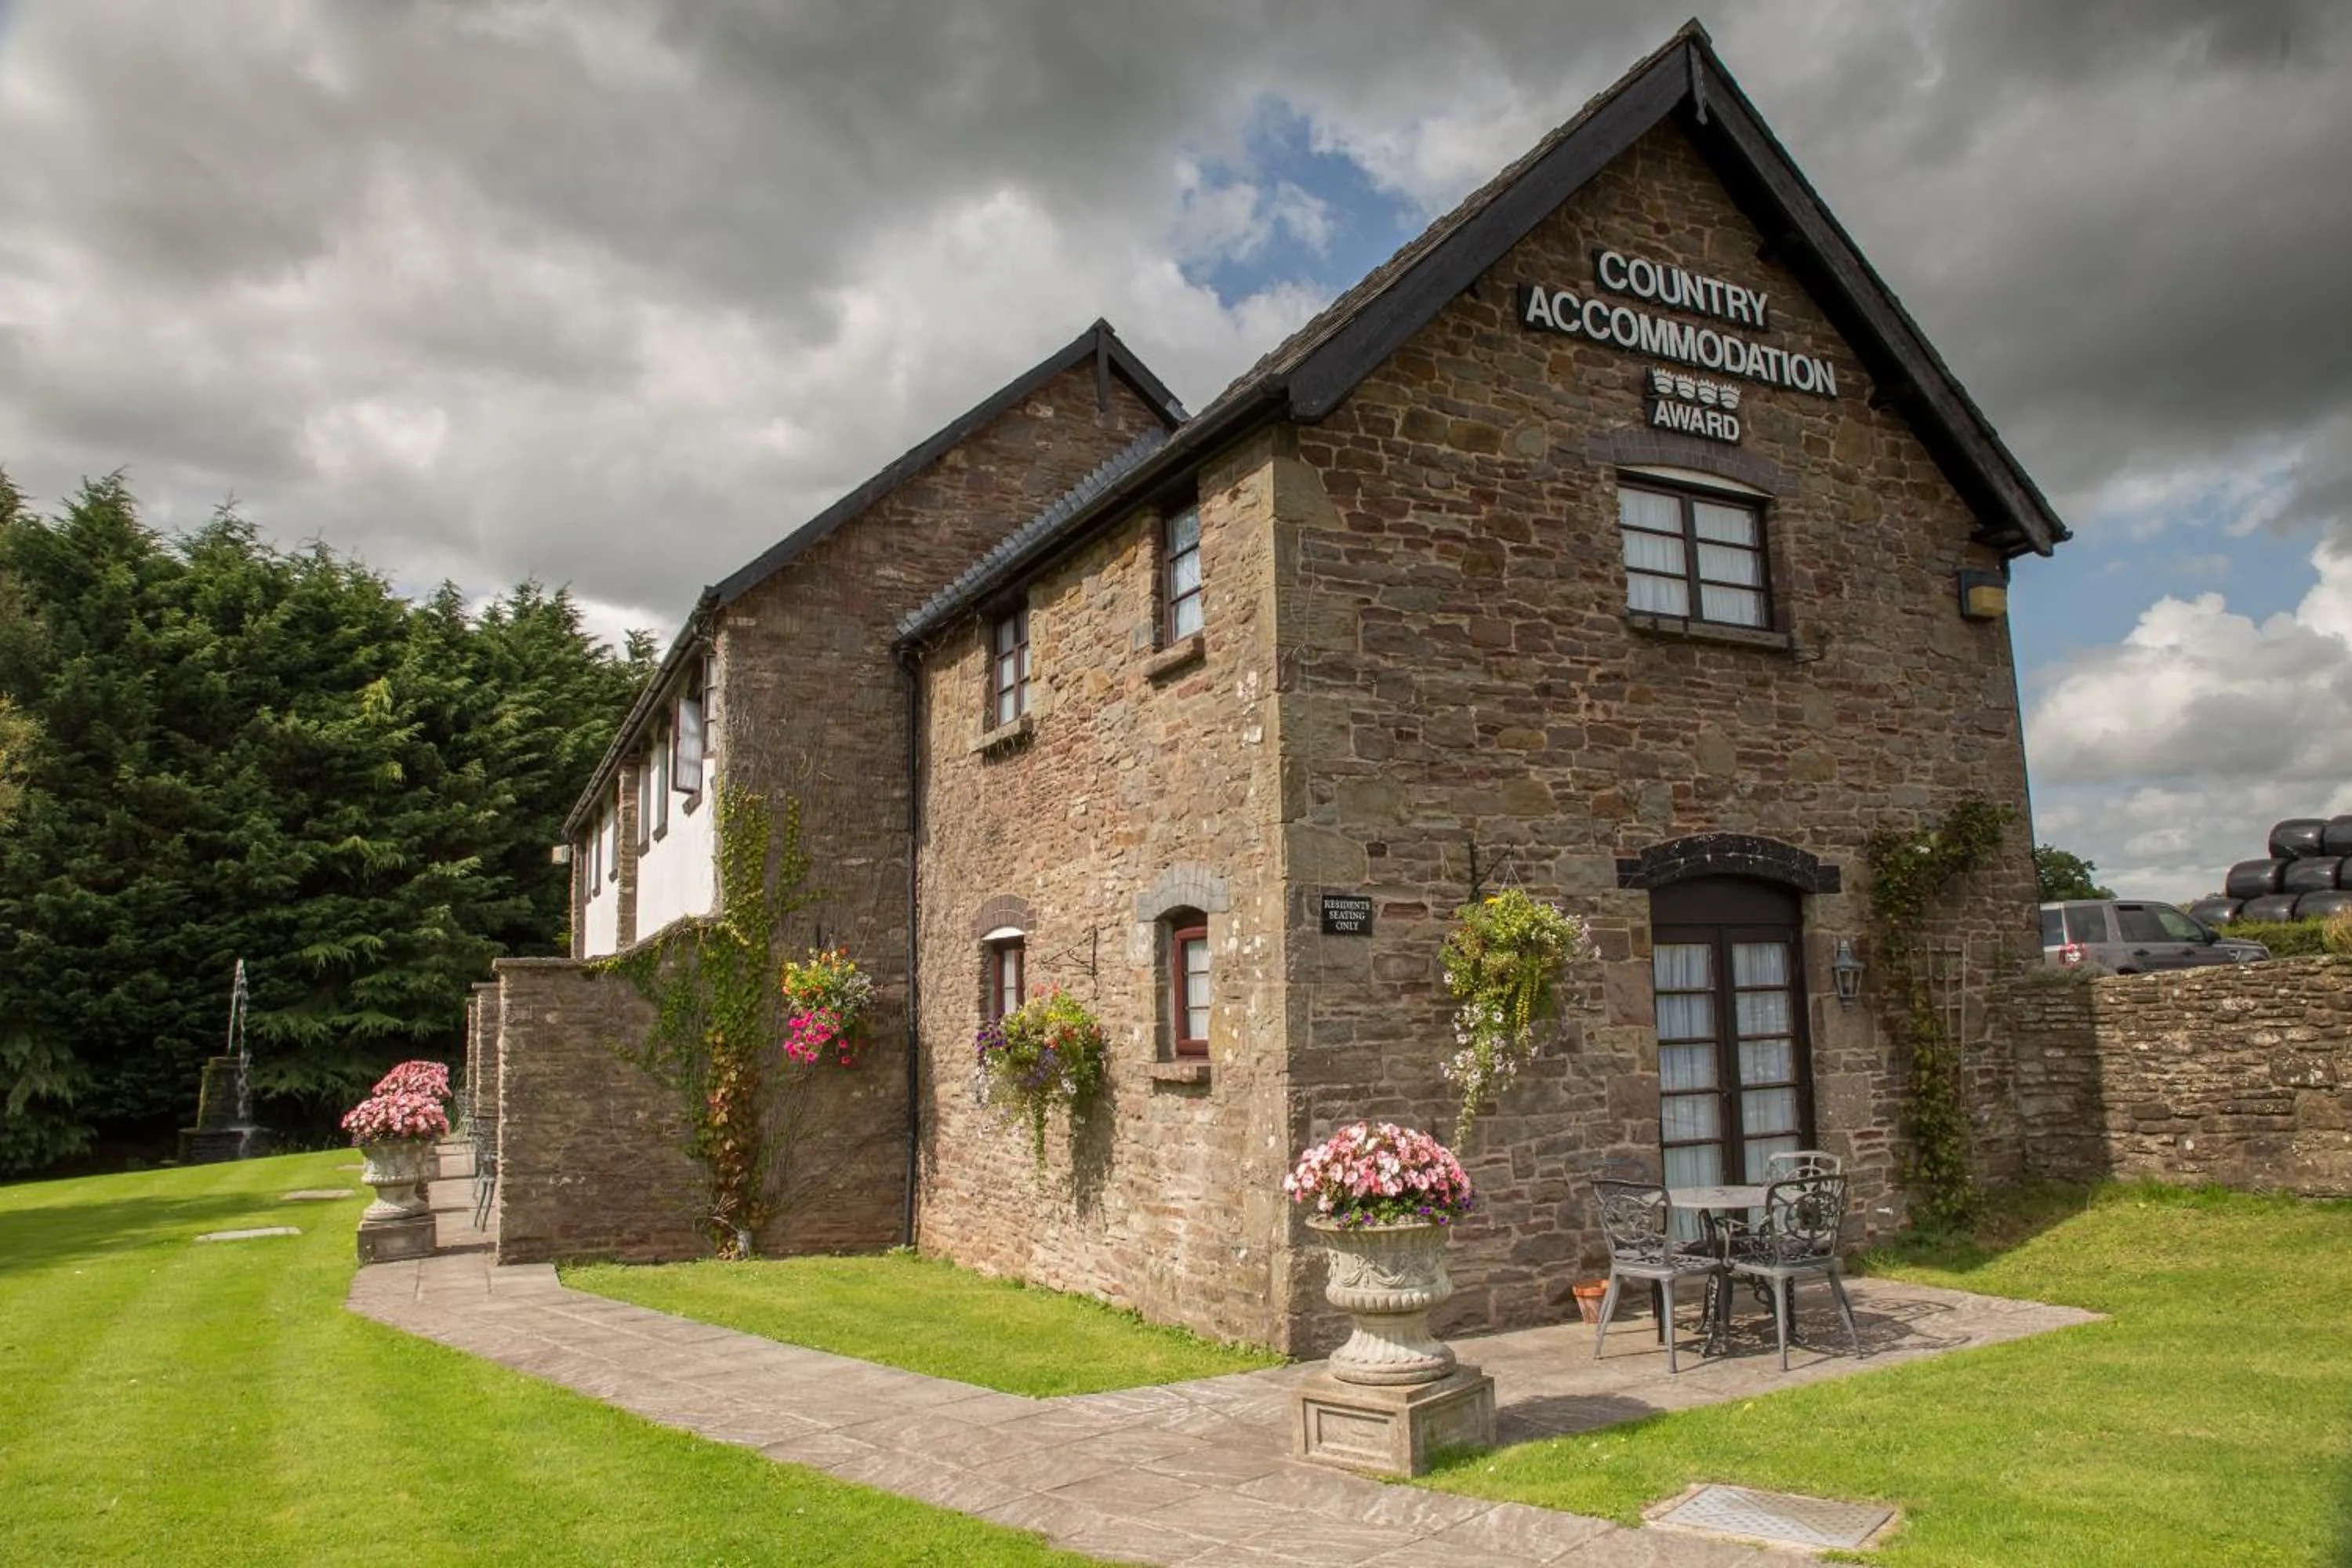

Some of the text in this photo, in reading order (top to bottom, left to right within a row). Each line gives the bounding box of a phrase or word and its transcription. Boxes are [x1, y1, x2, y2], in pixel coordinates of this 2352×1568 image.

[1599, 251, 1768, 327] COUNTRY
[1525, 286, 1838, 397] ACCOMMODATION
[1653, 401, 1740, 441] AWARD
[1323, 899, 1370, 909] RESIDENTS
[1329, 910, 1365, 920] SEATING
[1335, 921, 1359, 931] ONLY
